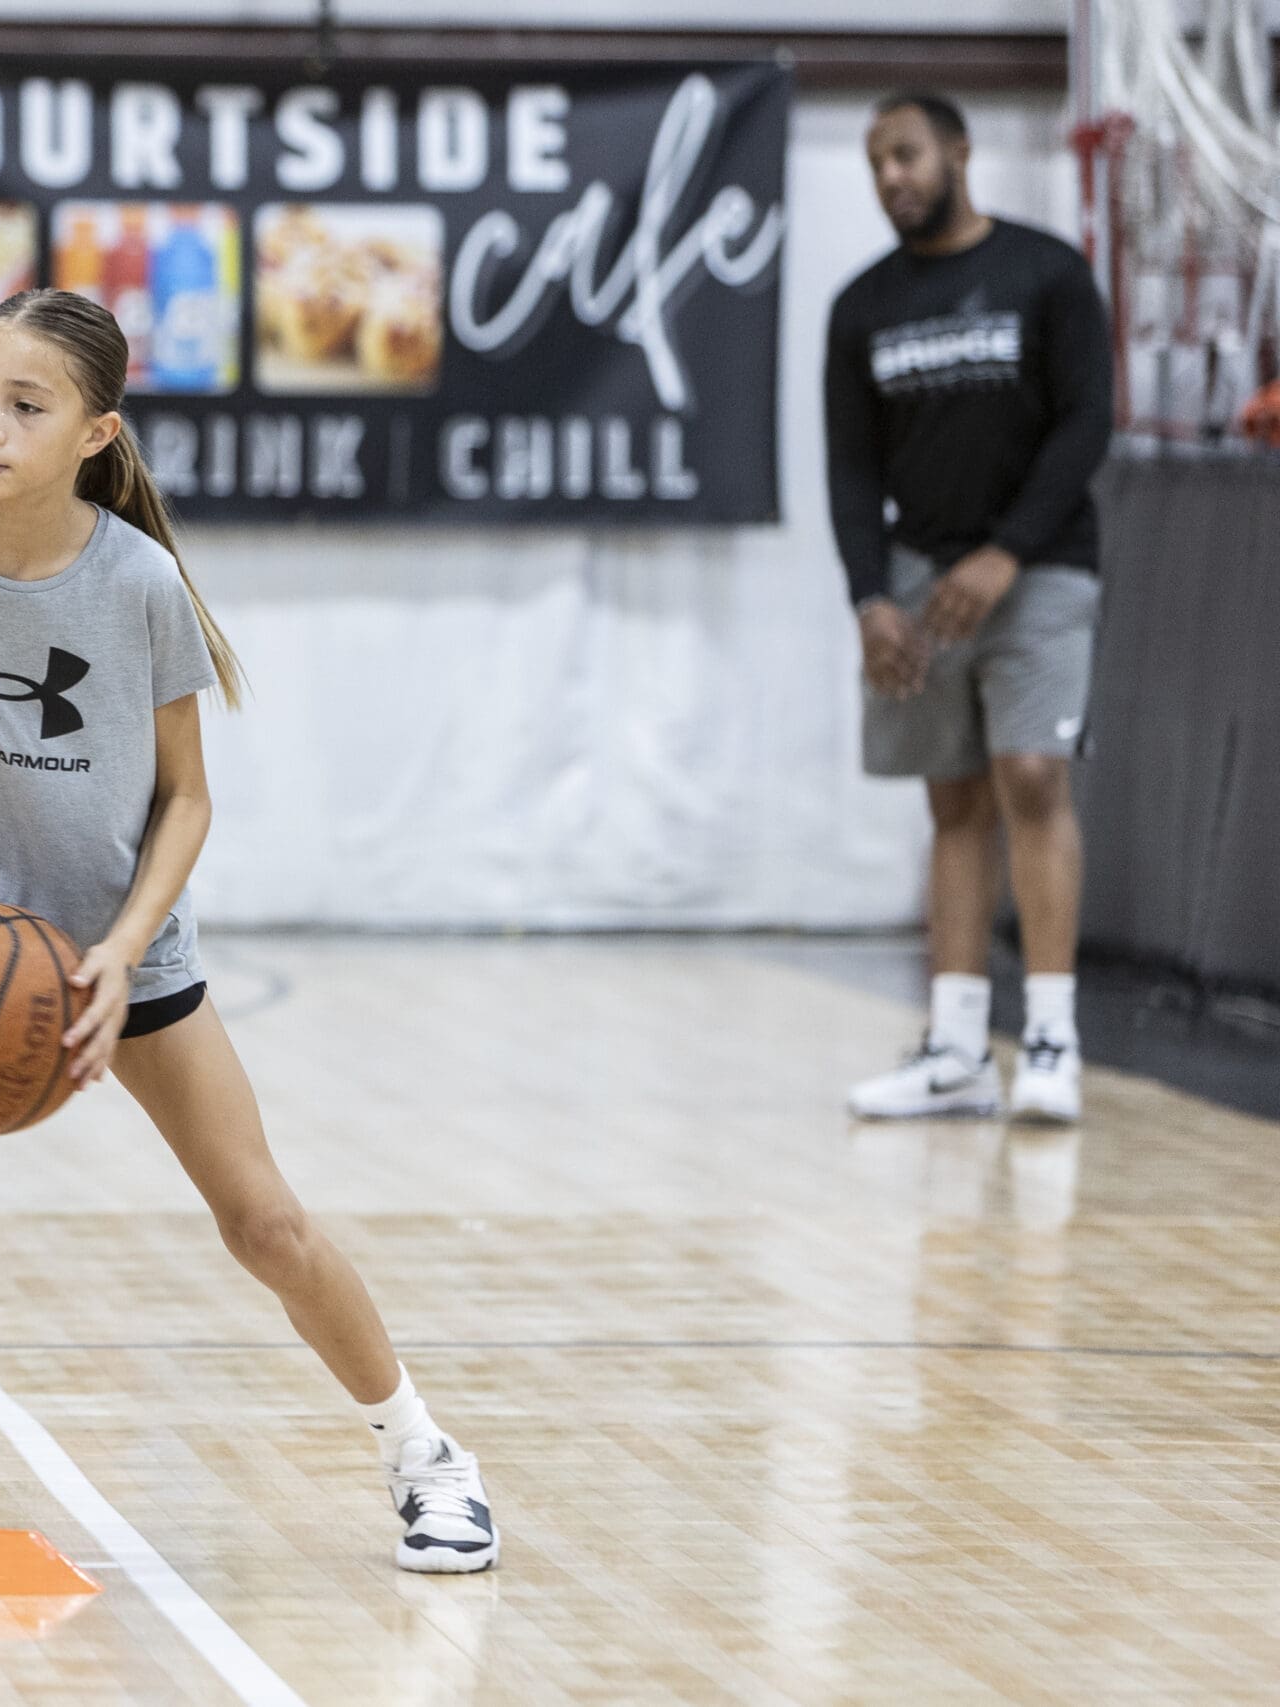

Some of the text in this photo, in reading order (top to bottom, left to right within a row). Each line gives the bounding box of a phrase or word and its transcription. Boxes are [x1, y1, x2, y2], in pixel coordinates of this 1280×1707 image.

[449, 72, 783, 411] cafe
[144, 411, 366, 498] RINK
[439, 414, 700, 500] CHILL
